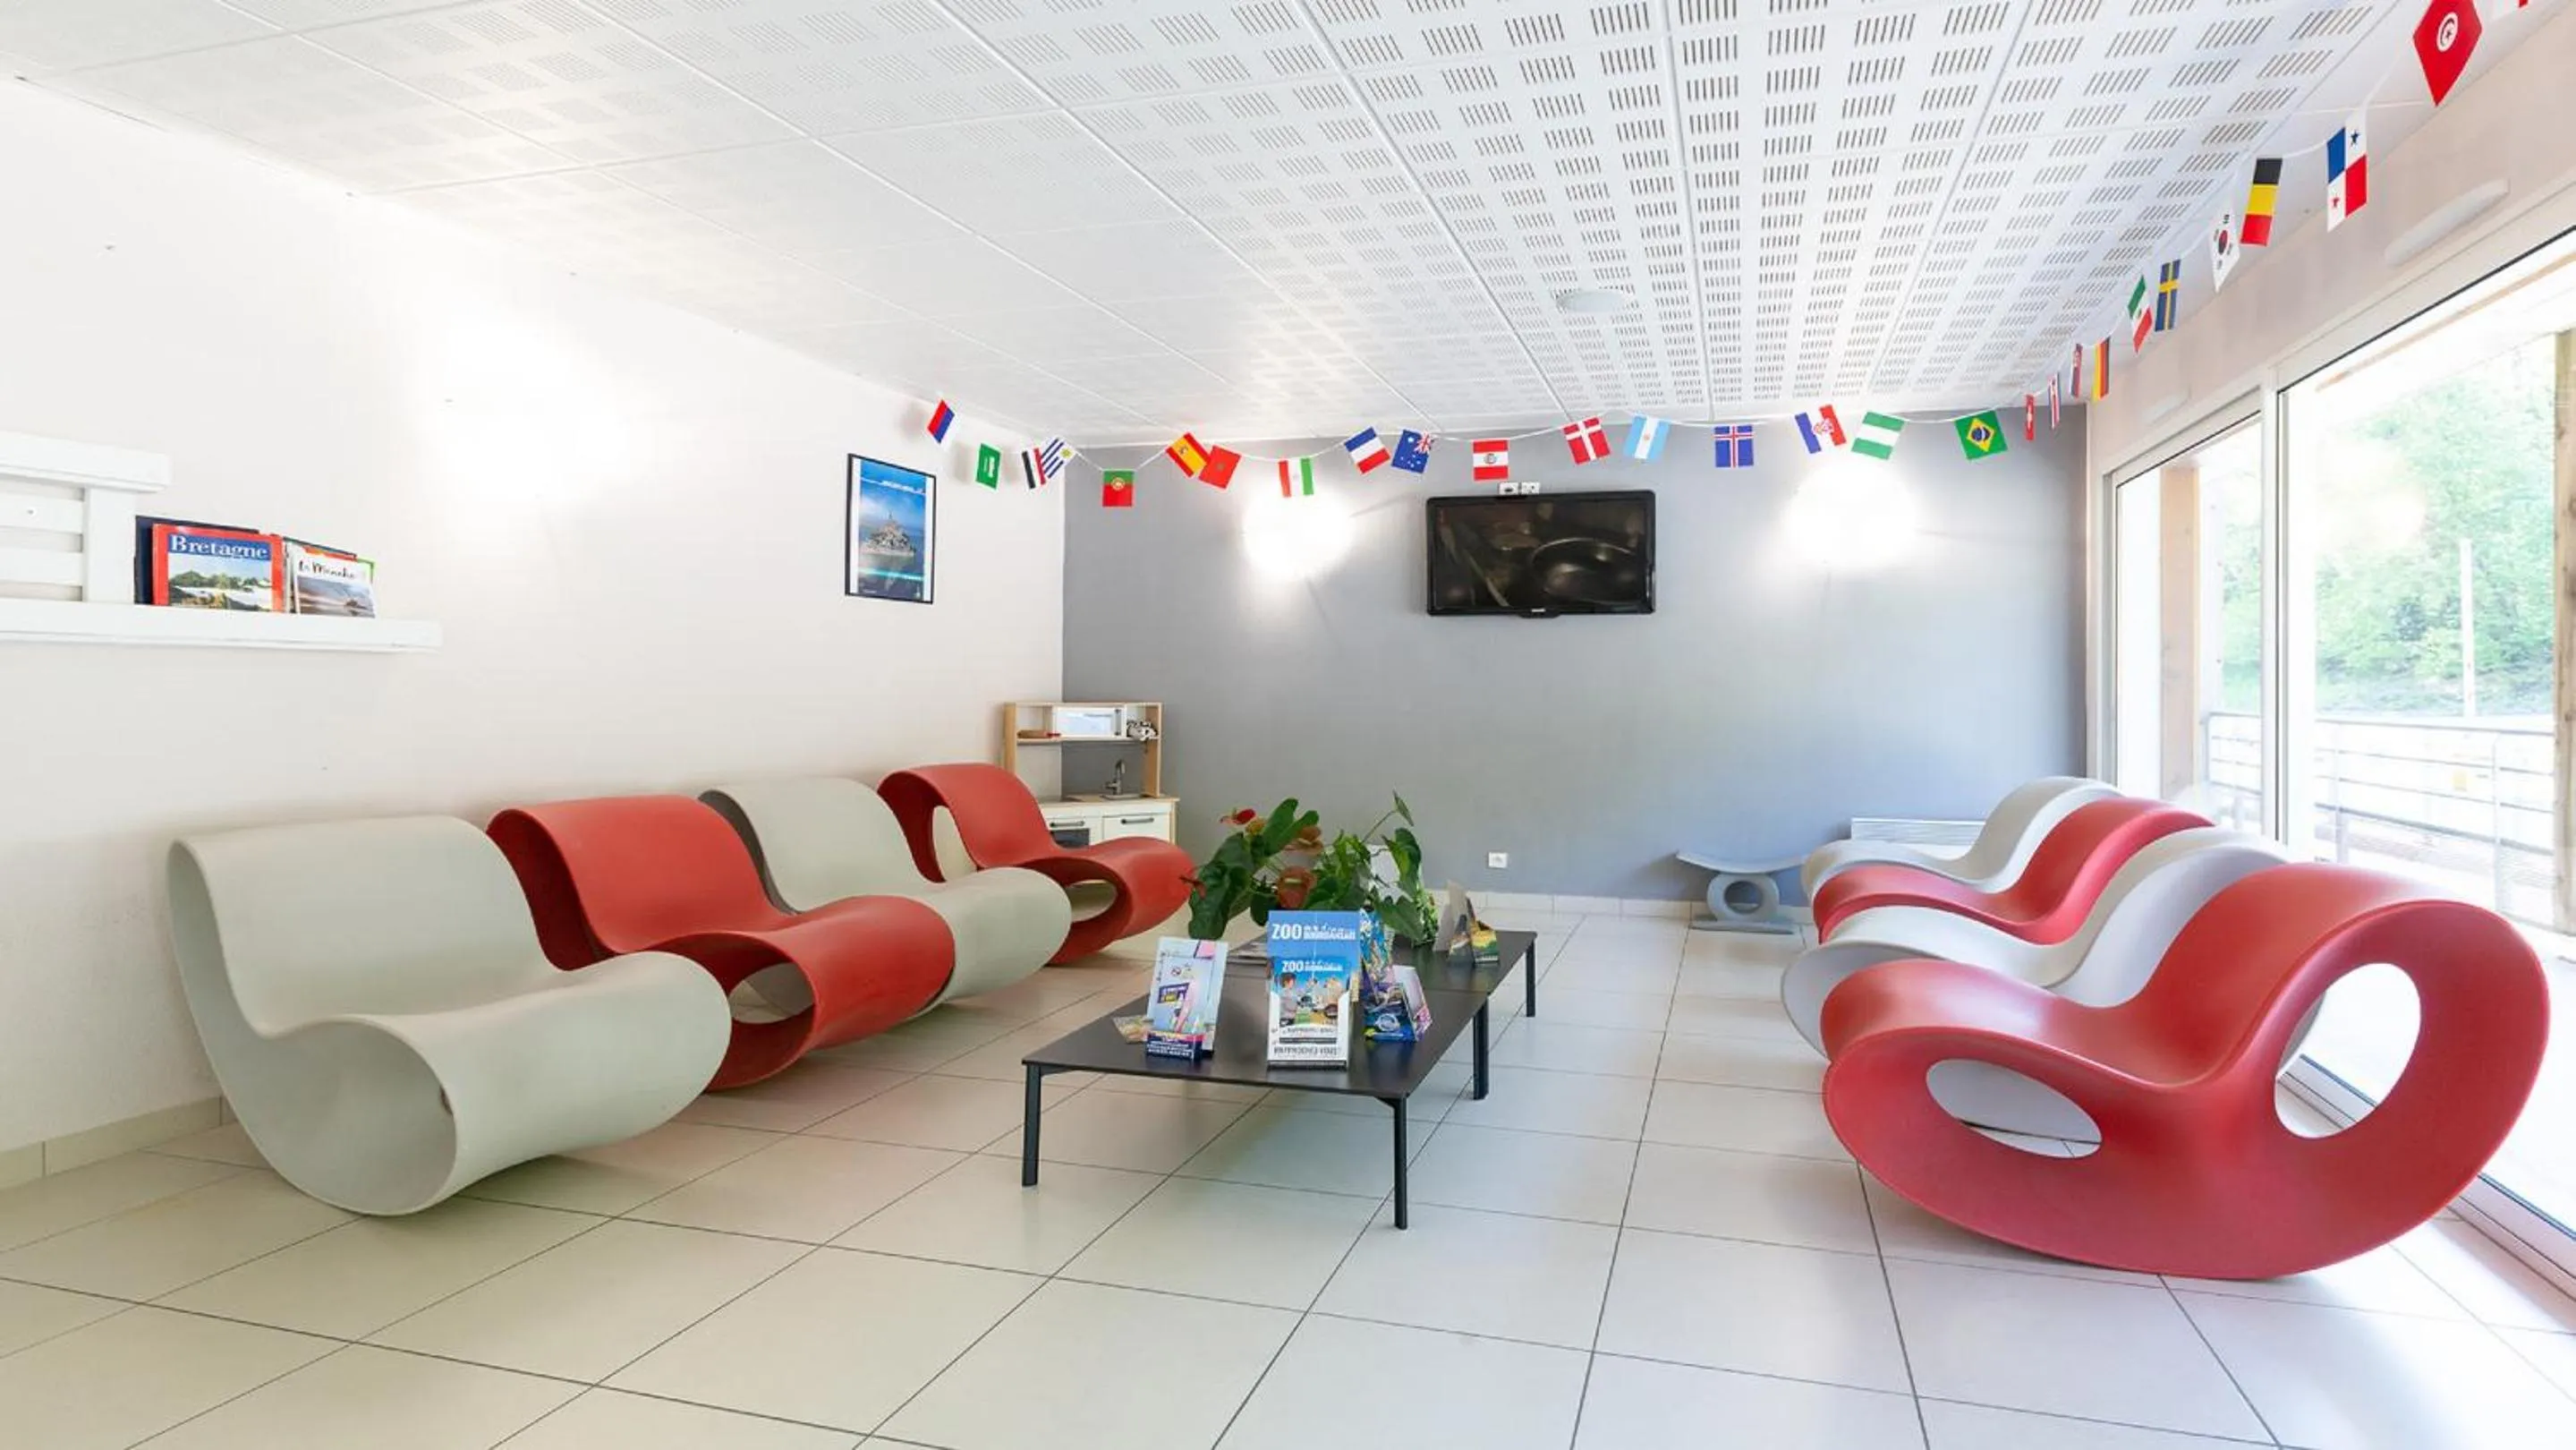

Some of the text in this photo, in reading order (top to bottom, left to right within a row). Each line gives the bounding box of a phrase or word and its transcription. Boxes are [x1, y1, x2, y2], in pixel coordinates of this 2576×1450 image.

[171, 534, 268, 559] Bretagne
[1271, 923, 1303, 940] ZOO
[1281, 960, 1304, 973] ZOO
